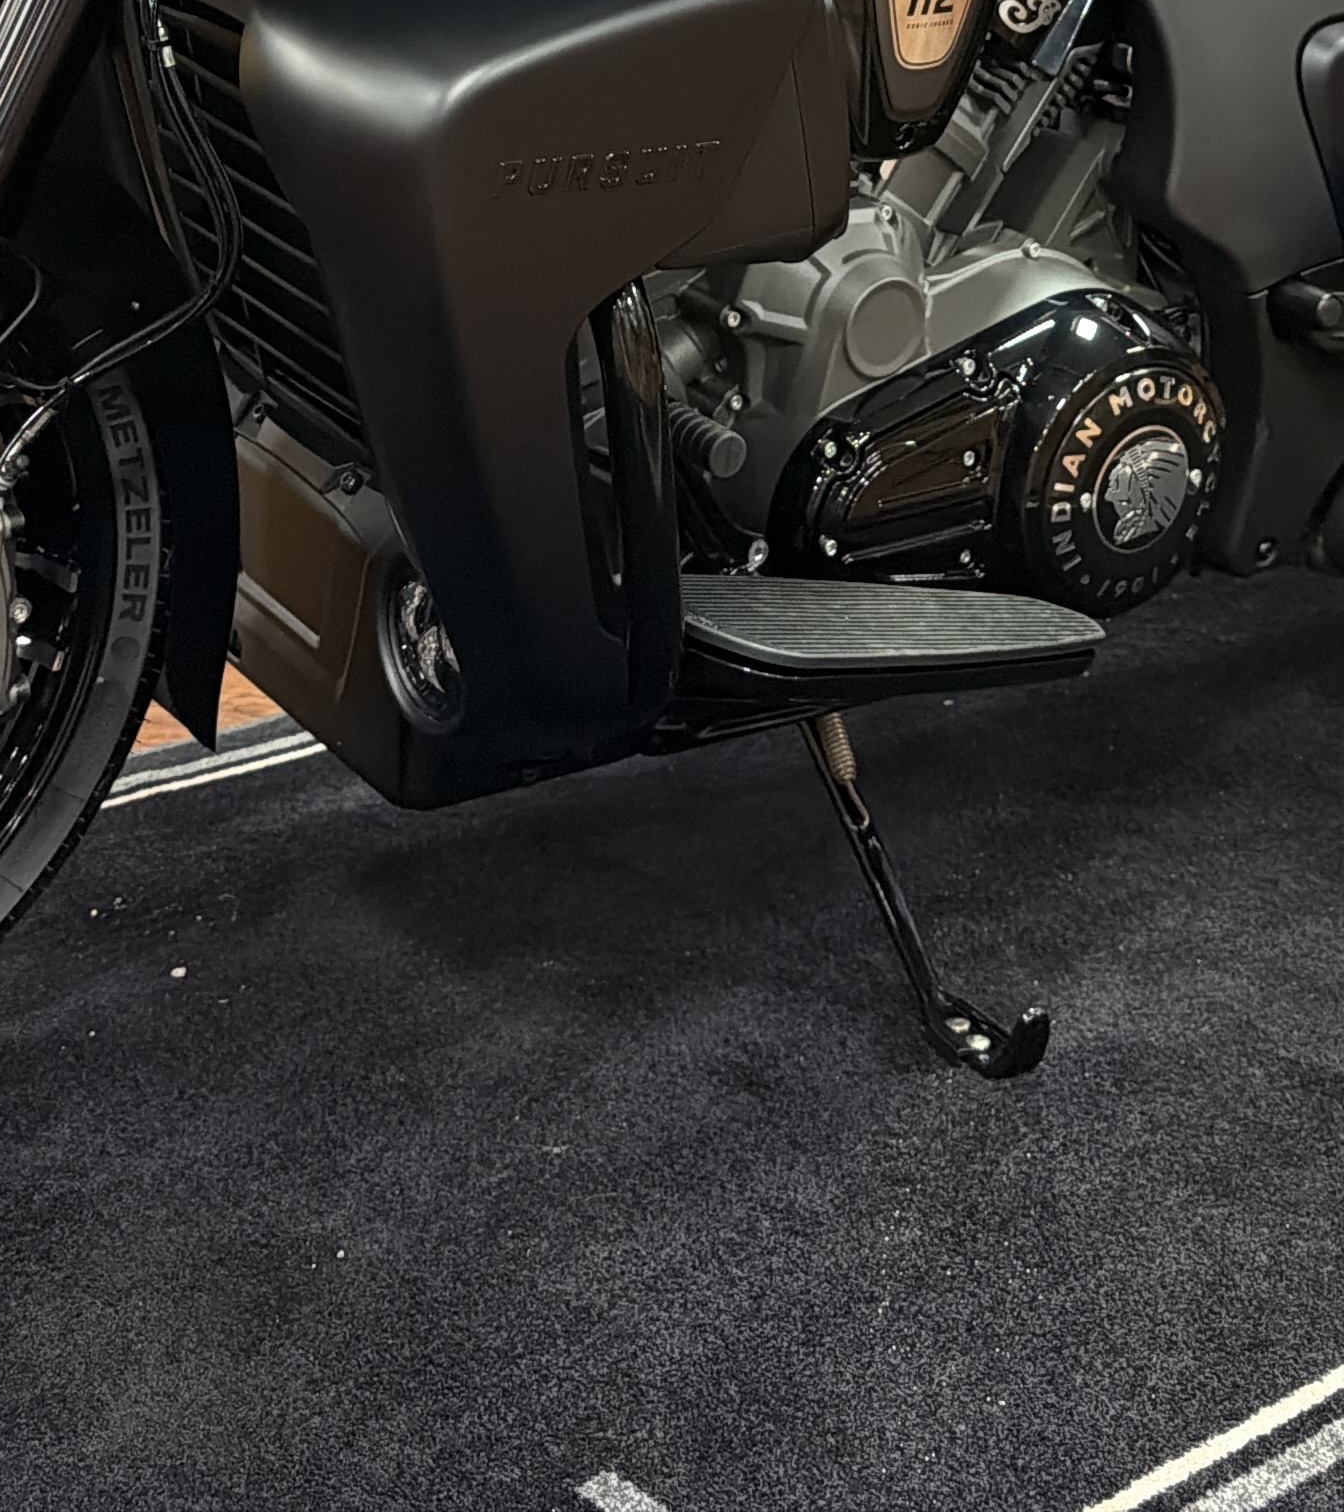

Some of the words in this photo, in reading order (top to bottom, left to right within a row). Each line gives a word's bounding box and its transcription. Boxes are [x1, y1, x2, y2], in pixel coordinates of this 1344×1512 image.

[492, 140, 721, 199] PURSUIT
[99, 384, 154, 624] METZELER
[1051, 417, 1103, 572] INDIAN
